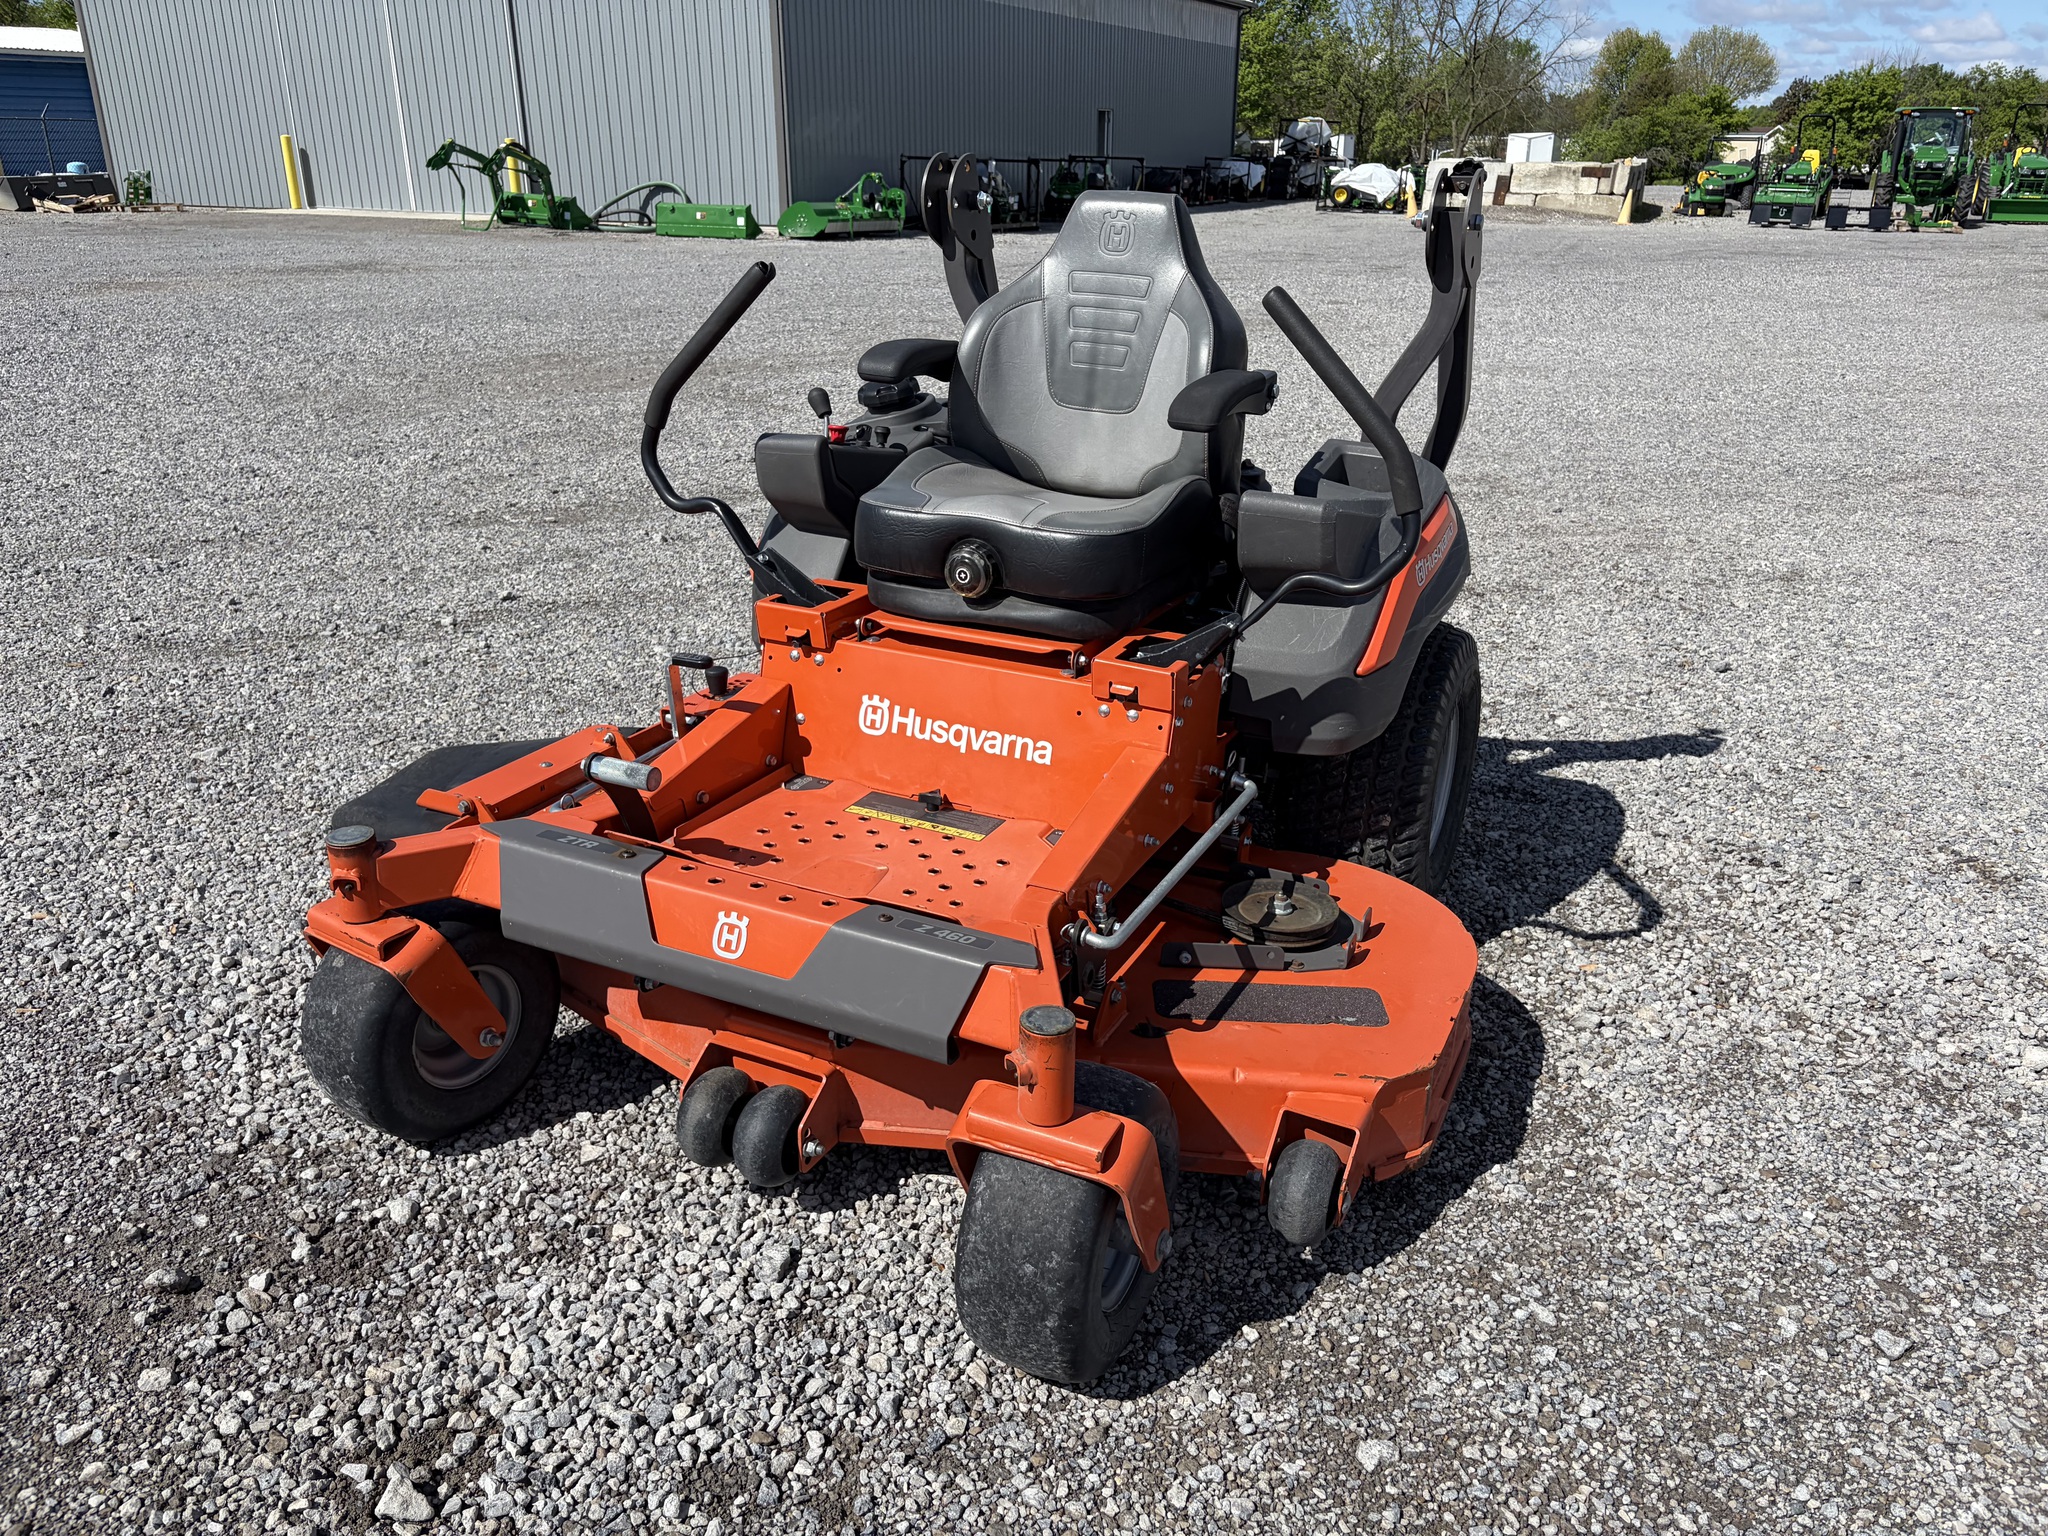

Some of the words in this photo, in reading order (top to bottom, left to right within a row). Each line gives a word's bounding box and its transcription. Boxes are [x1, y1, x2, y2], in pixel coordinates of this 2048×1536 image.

[1423, 522, 1454, 575] Husqvarna
[891, 705, 1053, 766] Husqvarna
[556, 835, 600, 849] ZTR
[913, 924, 931, 933] Z
[933, 929, 977, 944] 460
